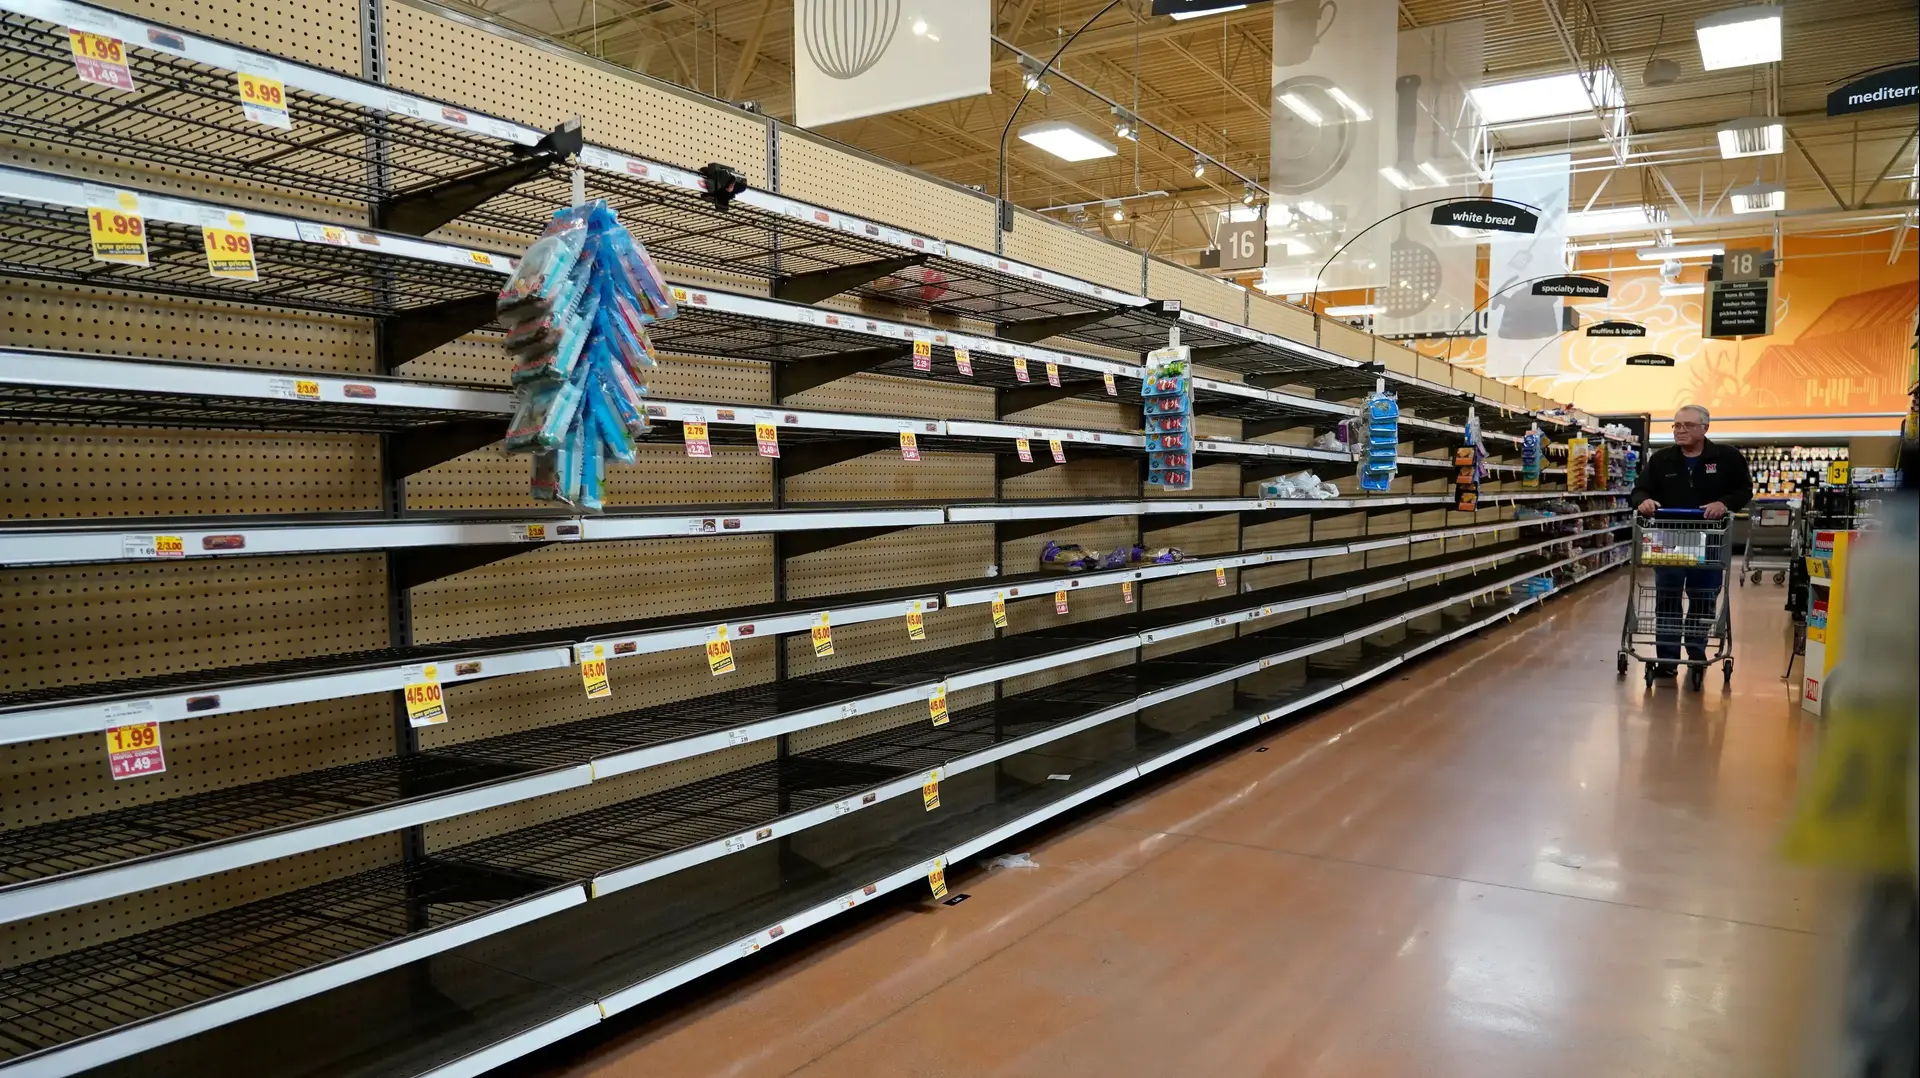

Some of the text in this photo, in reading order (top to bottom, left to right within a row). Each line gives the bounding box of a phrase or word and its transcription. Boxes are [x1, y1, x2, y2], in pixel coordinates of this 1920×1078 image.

[78, 35, 121, 62] 1.99
[88, 66, 119, 83] 1.49
[244, 81, 281, 104] 3.99
[1848, 85, 1919, 105] mediterr
[92, 212, 142, 237] 1.99
[1452, 211, 1516, 226] white bread
[207, 232, 250, 254] 1.99
[1229, 230, 1255, 259] 16
[1731, 254, 1753, 275] 18
[1542, 284, 1600, 294] specialty bread
[1621, 328, 1642, 336] bagels
[915, 344, 929, 356] 2.79
[297, 384, 319, 394] 2/3.00
[687, 426, 704, 435] 2.79
[758, 428, 775, 440] 2.99
[901, 435, 915, 446] 2.99
[140, 547, 155, 555] 1.69
[157, 542, 182, 551] 2/3.00
[813, 626, 830, 641] 4/5.00
[707, 640, 730, 657] 4/5.00
[583, 661, 605, 678] 4/5.00
[407, 684, 441, 705] 4/5.00
[115, 727, 154, 750] 1.99
[121, 756, 151, 772] 1.49
